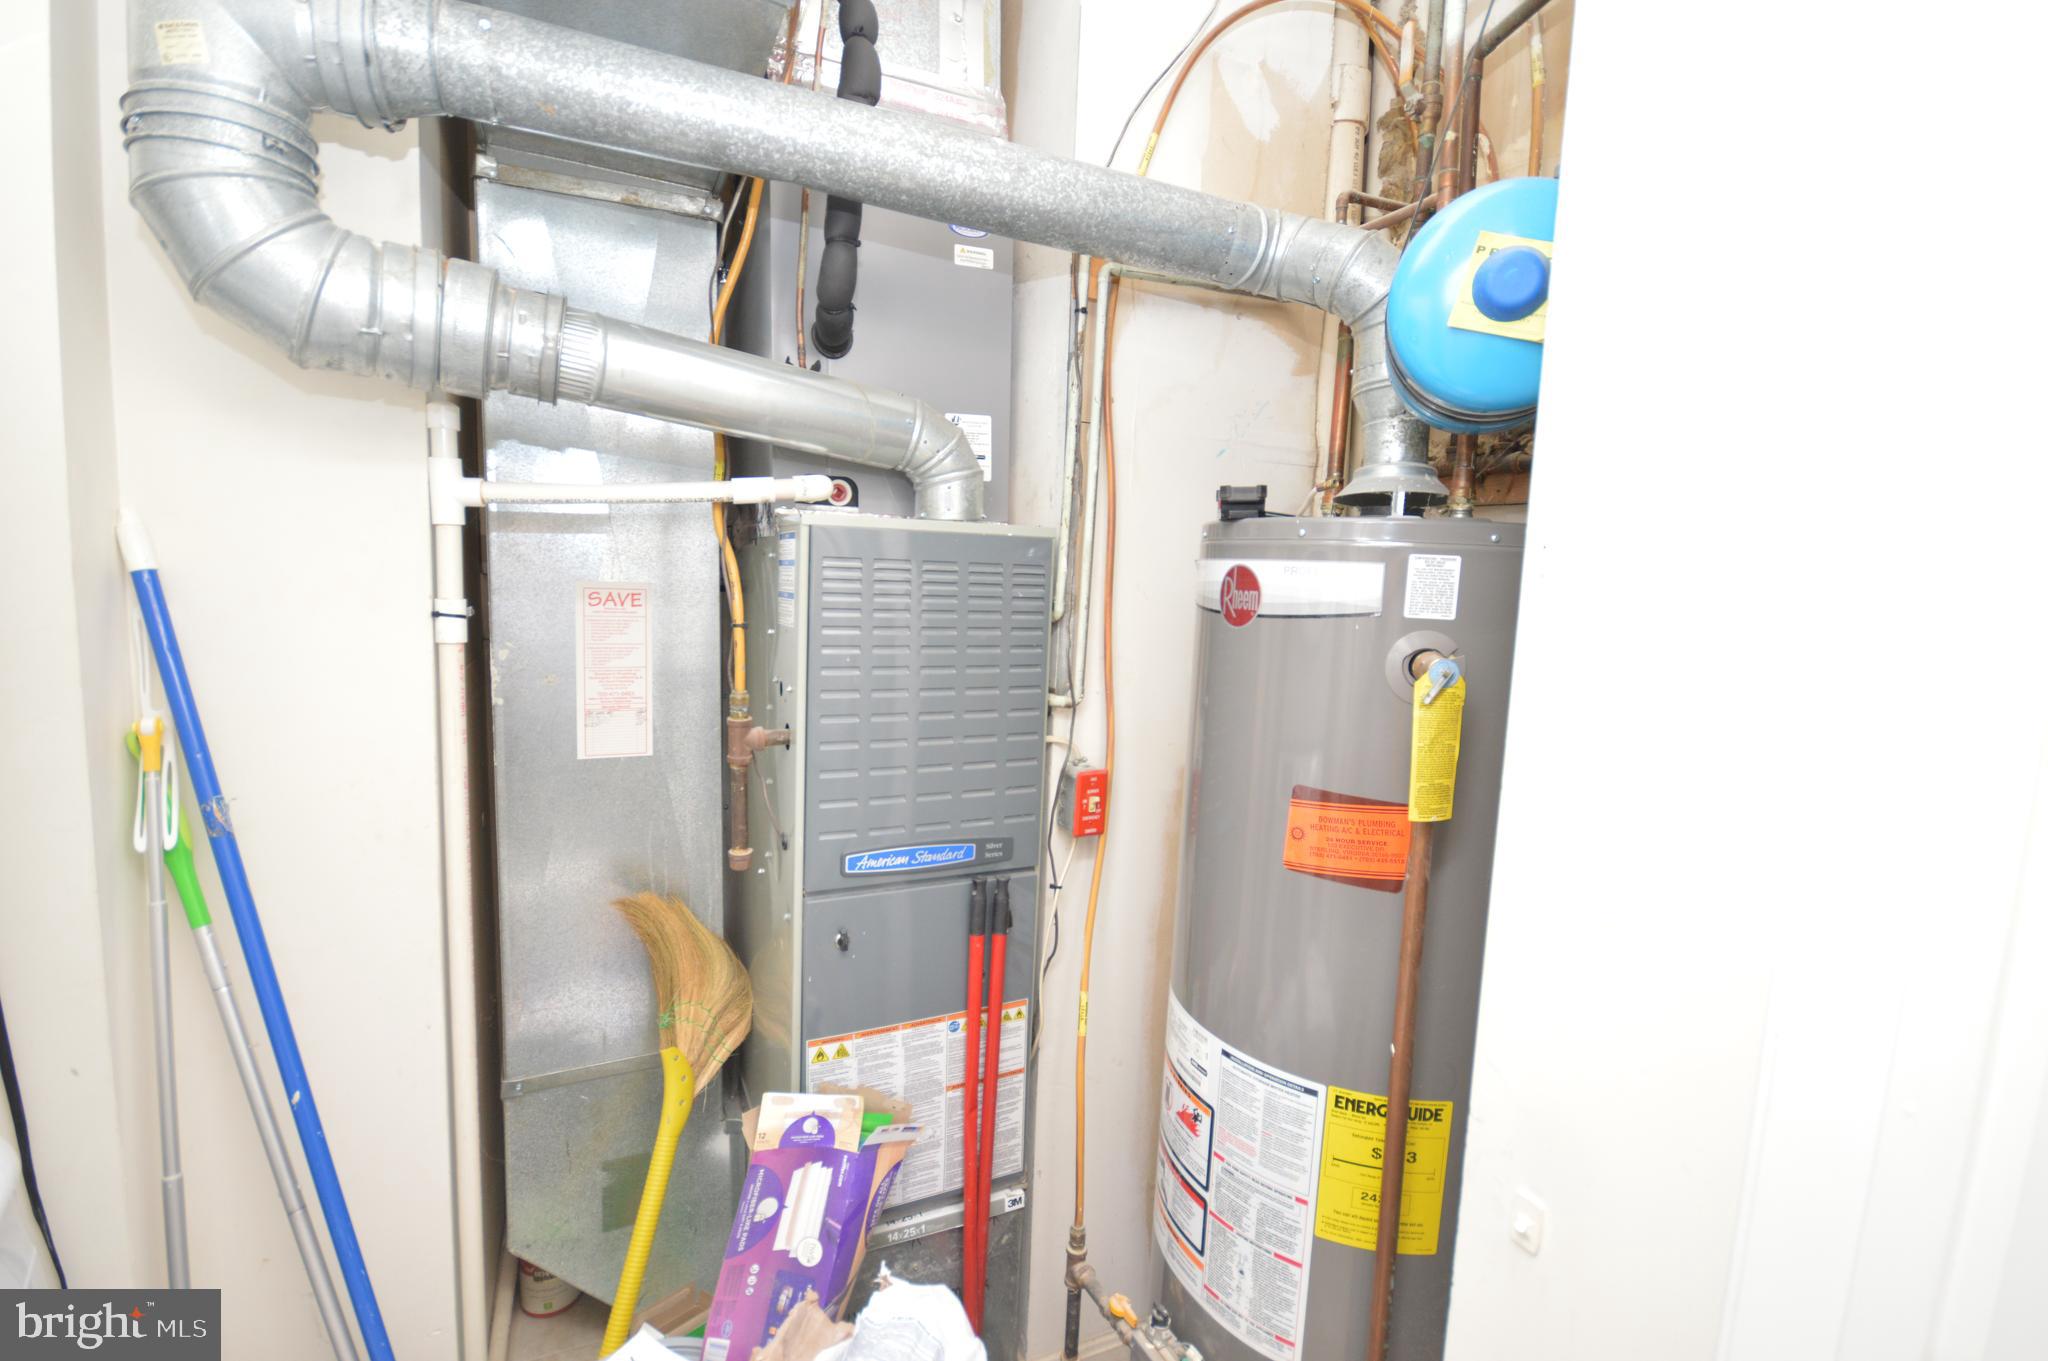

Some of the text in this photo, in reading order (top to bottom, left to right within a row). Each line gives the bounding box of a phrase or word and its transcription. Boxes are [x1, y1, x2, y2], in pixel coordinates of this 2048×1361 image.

[588, 591, 642, 607] SAVE
[1222, 566, 1259, 618] Rheem
[855, 846, 968, 871] American Standard
[1007, 1196, 1023, 1208] 3M
